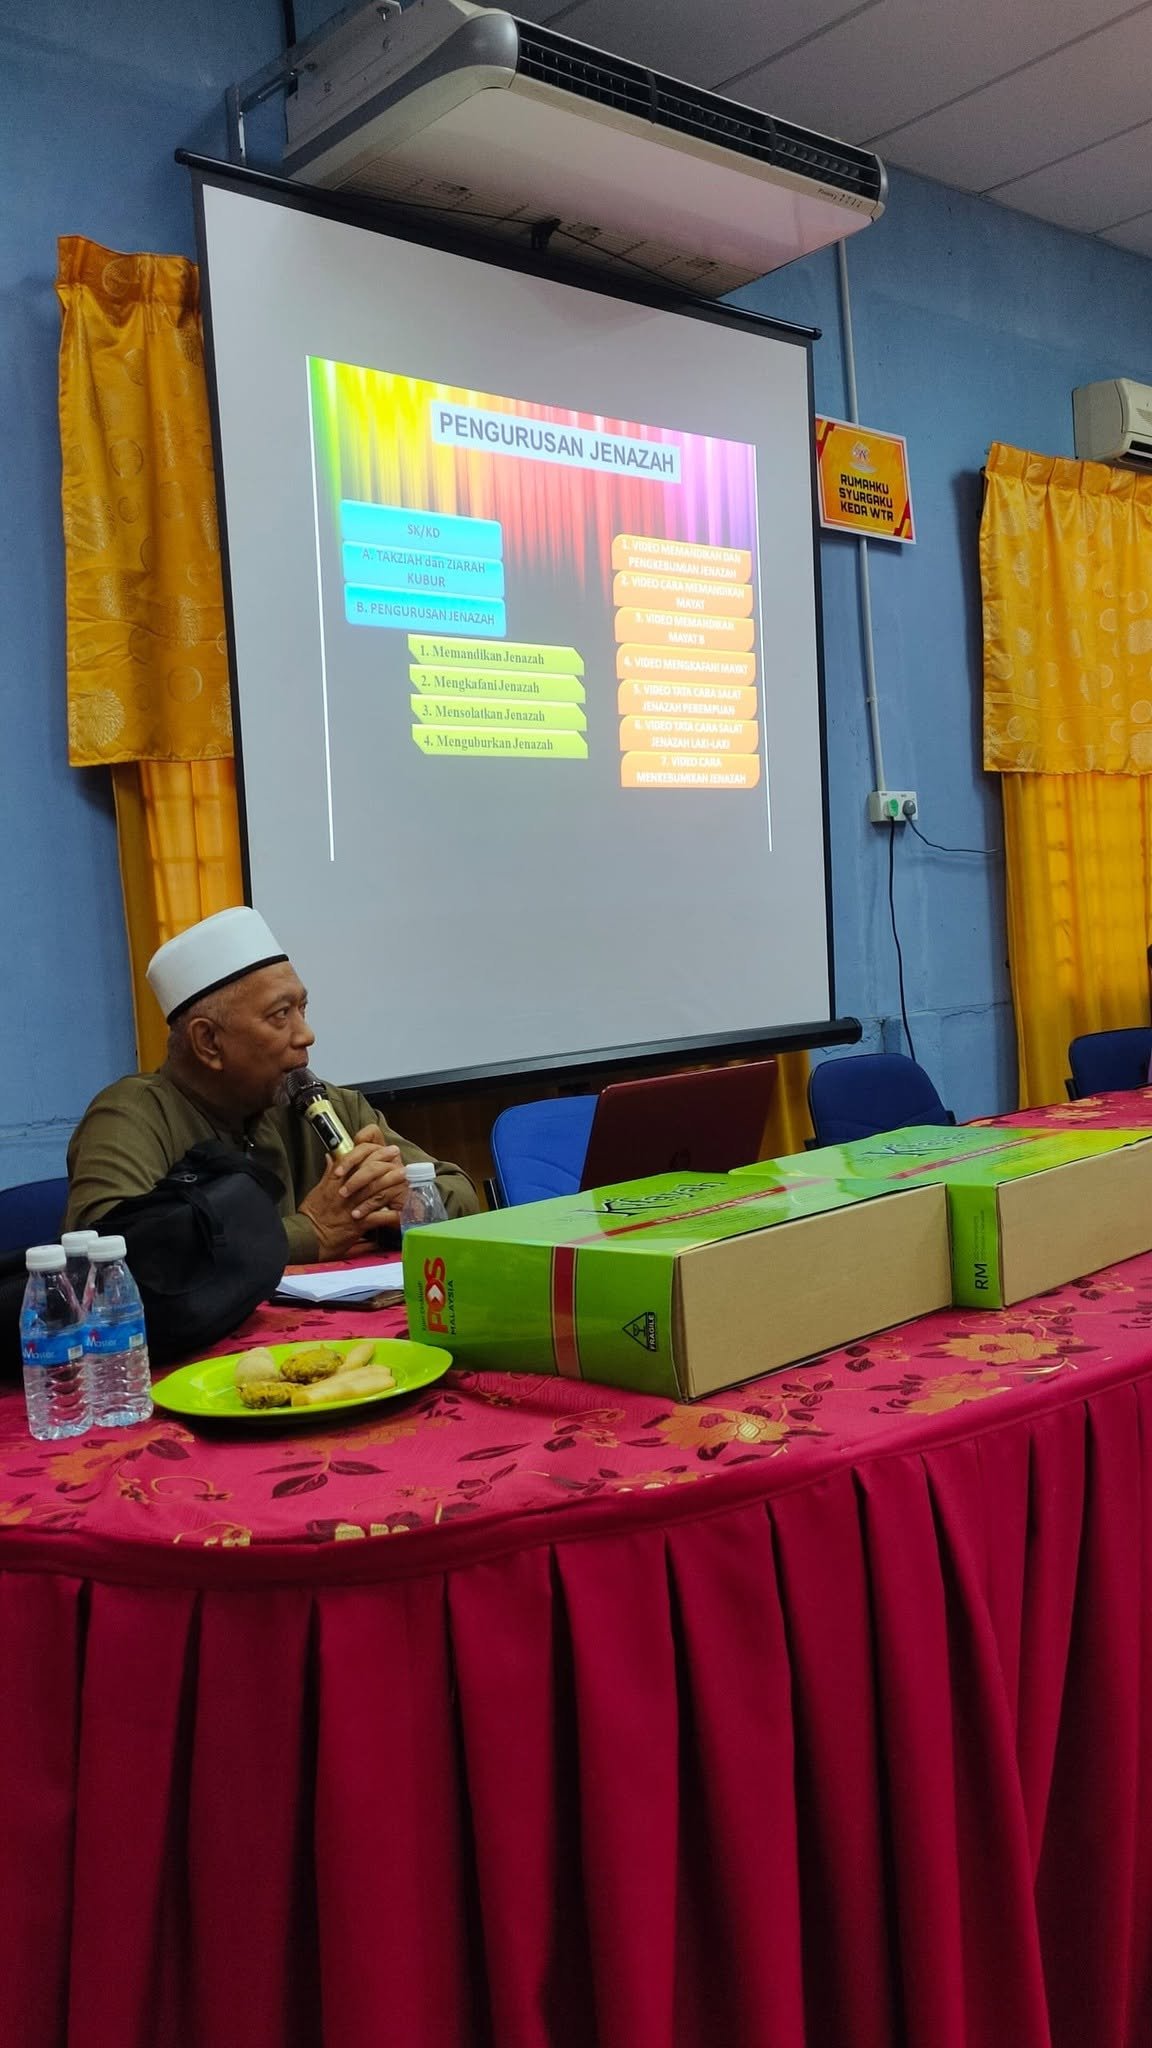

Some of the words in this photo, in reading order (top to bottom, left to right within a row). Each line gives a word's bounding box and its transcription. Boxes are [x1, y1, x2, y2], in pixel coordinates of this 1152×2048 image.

[439, 411, 584, 459] PENGURUSAN
[590, 440, 675, 474] JENAZAH
[840, 474, 889, 495] RUMAHKU
[838, 487, 893, 509] SYURGAKU
[840, 501, 868, 516] KEDA
[870, 508, 894, 522] WTR
[407, 524, 440, 539] SK/KD
[633, 540, 660, 554] VIDEO
[362, 549, 374, 560] A.
[376, 549, 423, 566] TAKZIAH
[424, 557, 445, 569] dan
[446, 559, 486, 574] ZIARAH
[407, 572, 446, 587] KUBUR
[633, 577, 660, 589] VIDEO
[356, 601, 368, 613] B.
[370, 603, 447, 621] PENGURUSAN
[447, 611, 496, 625] JENAZAH
[647, 613, 673, 625] VIDEO
[420, 645, 430, 657] 1.
[432, 645, 503, 662] Memandikan
[503, 651, 545, 665] Jenazah
[636, 656, 662, 669] VIDEO
[421, 675, 431, 687] 2.
[434, 675, 497, 692] Mengkafani
[498, 682, 540, 694] Jenazah
[645, 685, 671, 696] VIDEO
[422, 704, 432, 717] 3.
[435, 704, 503, 721] Mensolatkan
[504, 708, 546, 722] Jenazah
[646, 720, 673, 732] VIDEO
[423, 735, 433, 746] 4.
[436, 734, 511, 751] Menguburkan
[512, 738, 553, 751] Jenazah
[672, 756, 698, 768] VIDEO
[973, 1263, 989, 1290] RM
[424, 1256, 449, 1334] POS
[447, 1280, 457, 1336] MALAYSIA
[647, 1314, 657, 1350] FRAGILE
